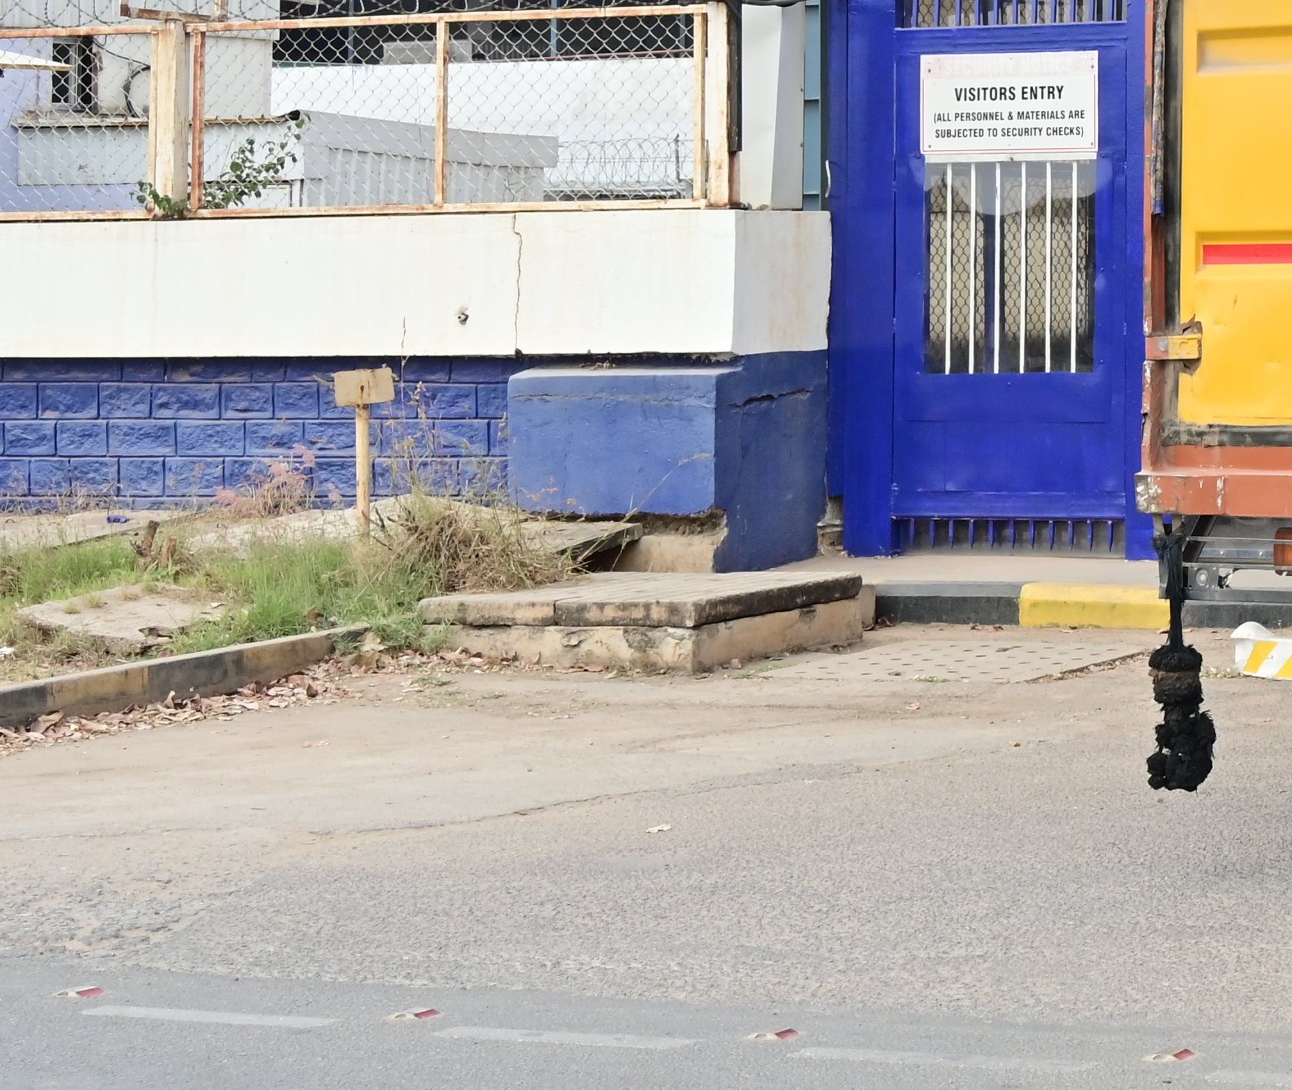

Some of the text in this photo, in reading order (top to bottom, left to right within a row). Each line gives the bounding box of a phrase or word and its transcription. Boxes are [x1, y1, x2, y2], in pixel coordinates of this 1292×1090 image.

[955, 85, 1064, 102] VISITORS ENTRY
[933, 109, 1085, 124] (ALL PERSONNEL & MATERIALS ARE
[935, 126, 1084, 138] SUBJECTED TO SECURITY CHECKS)
